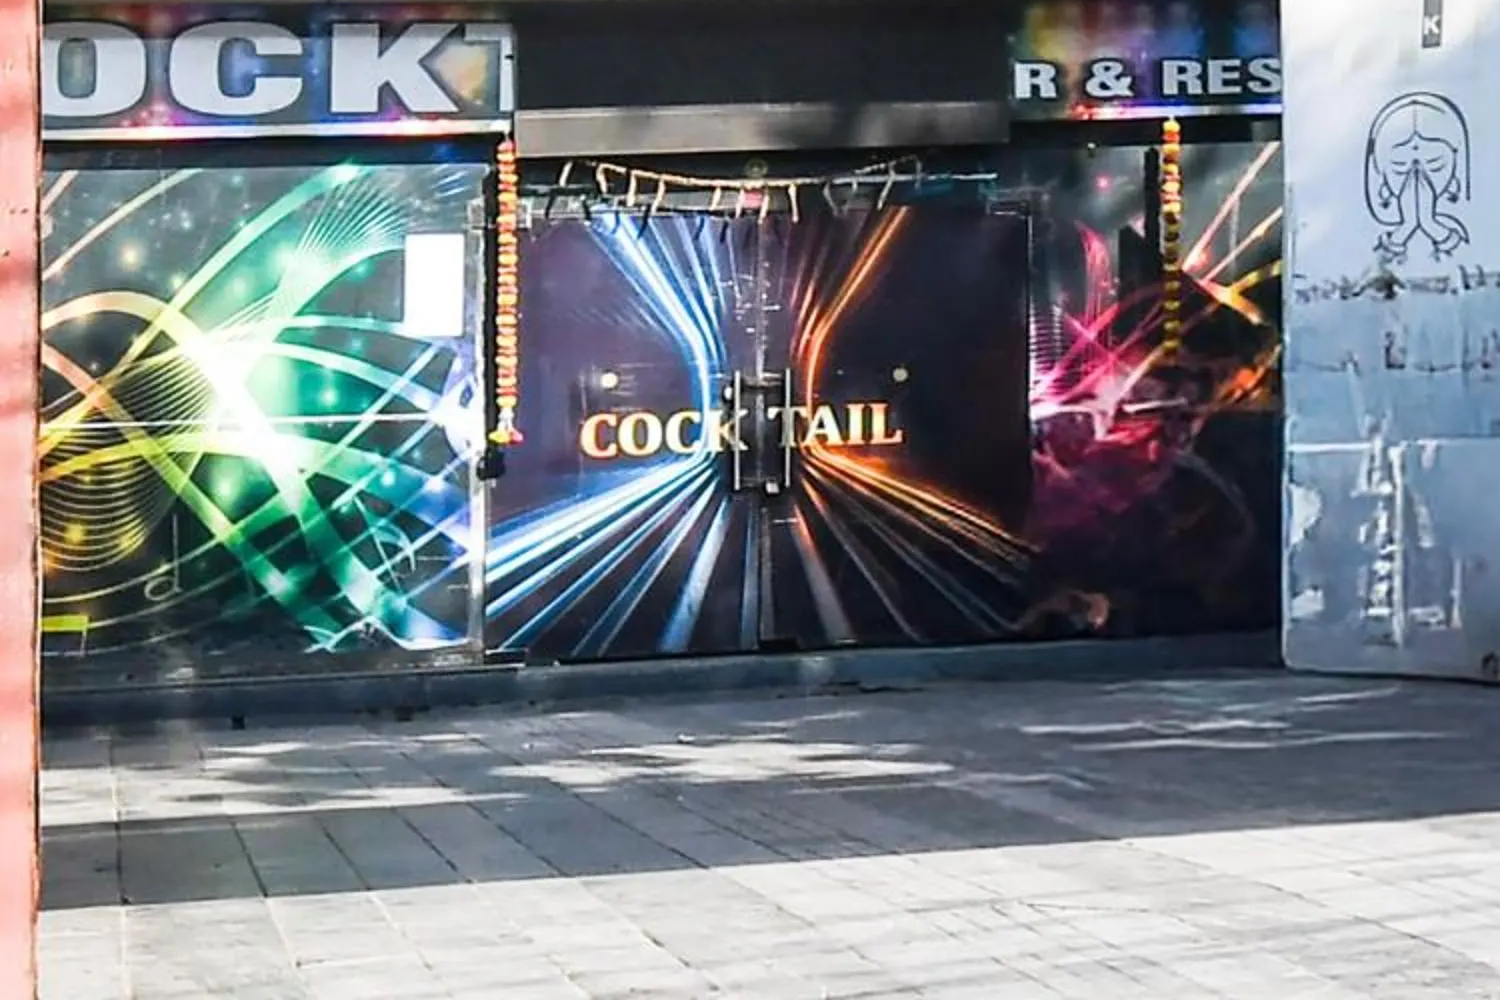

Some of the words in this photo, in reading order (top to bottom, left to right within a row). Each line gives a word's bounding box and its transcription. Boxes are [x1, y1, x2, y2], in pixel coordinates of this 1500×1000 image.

[1014, 62, 1057, 98] R
[1085, 60, 1133, 97] &
[1162, 58, 1281, 95] RES
